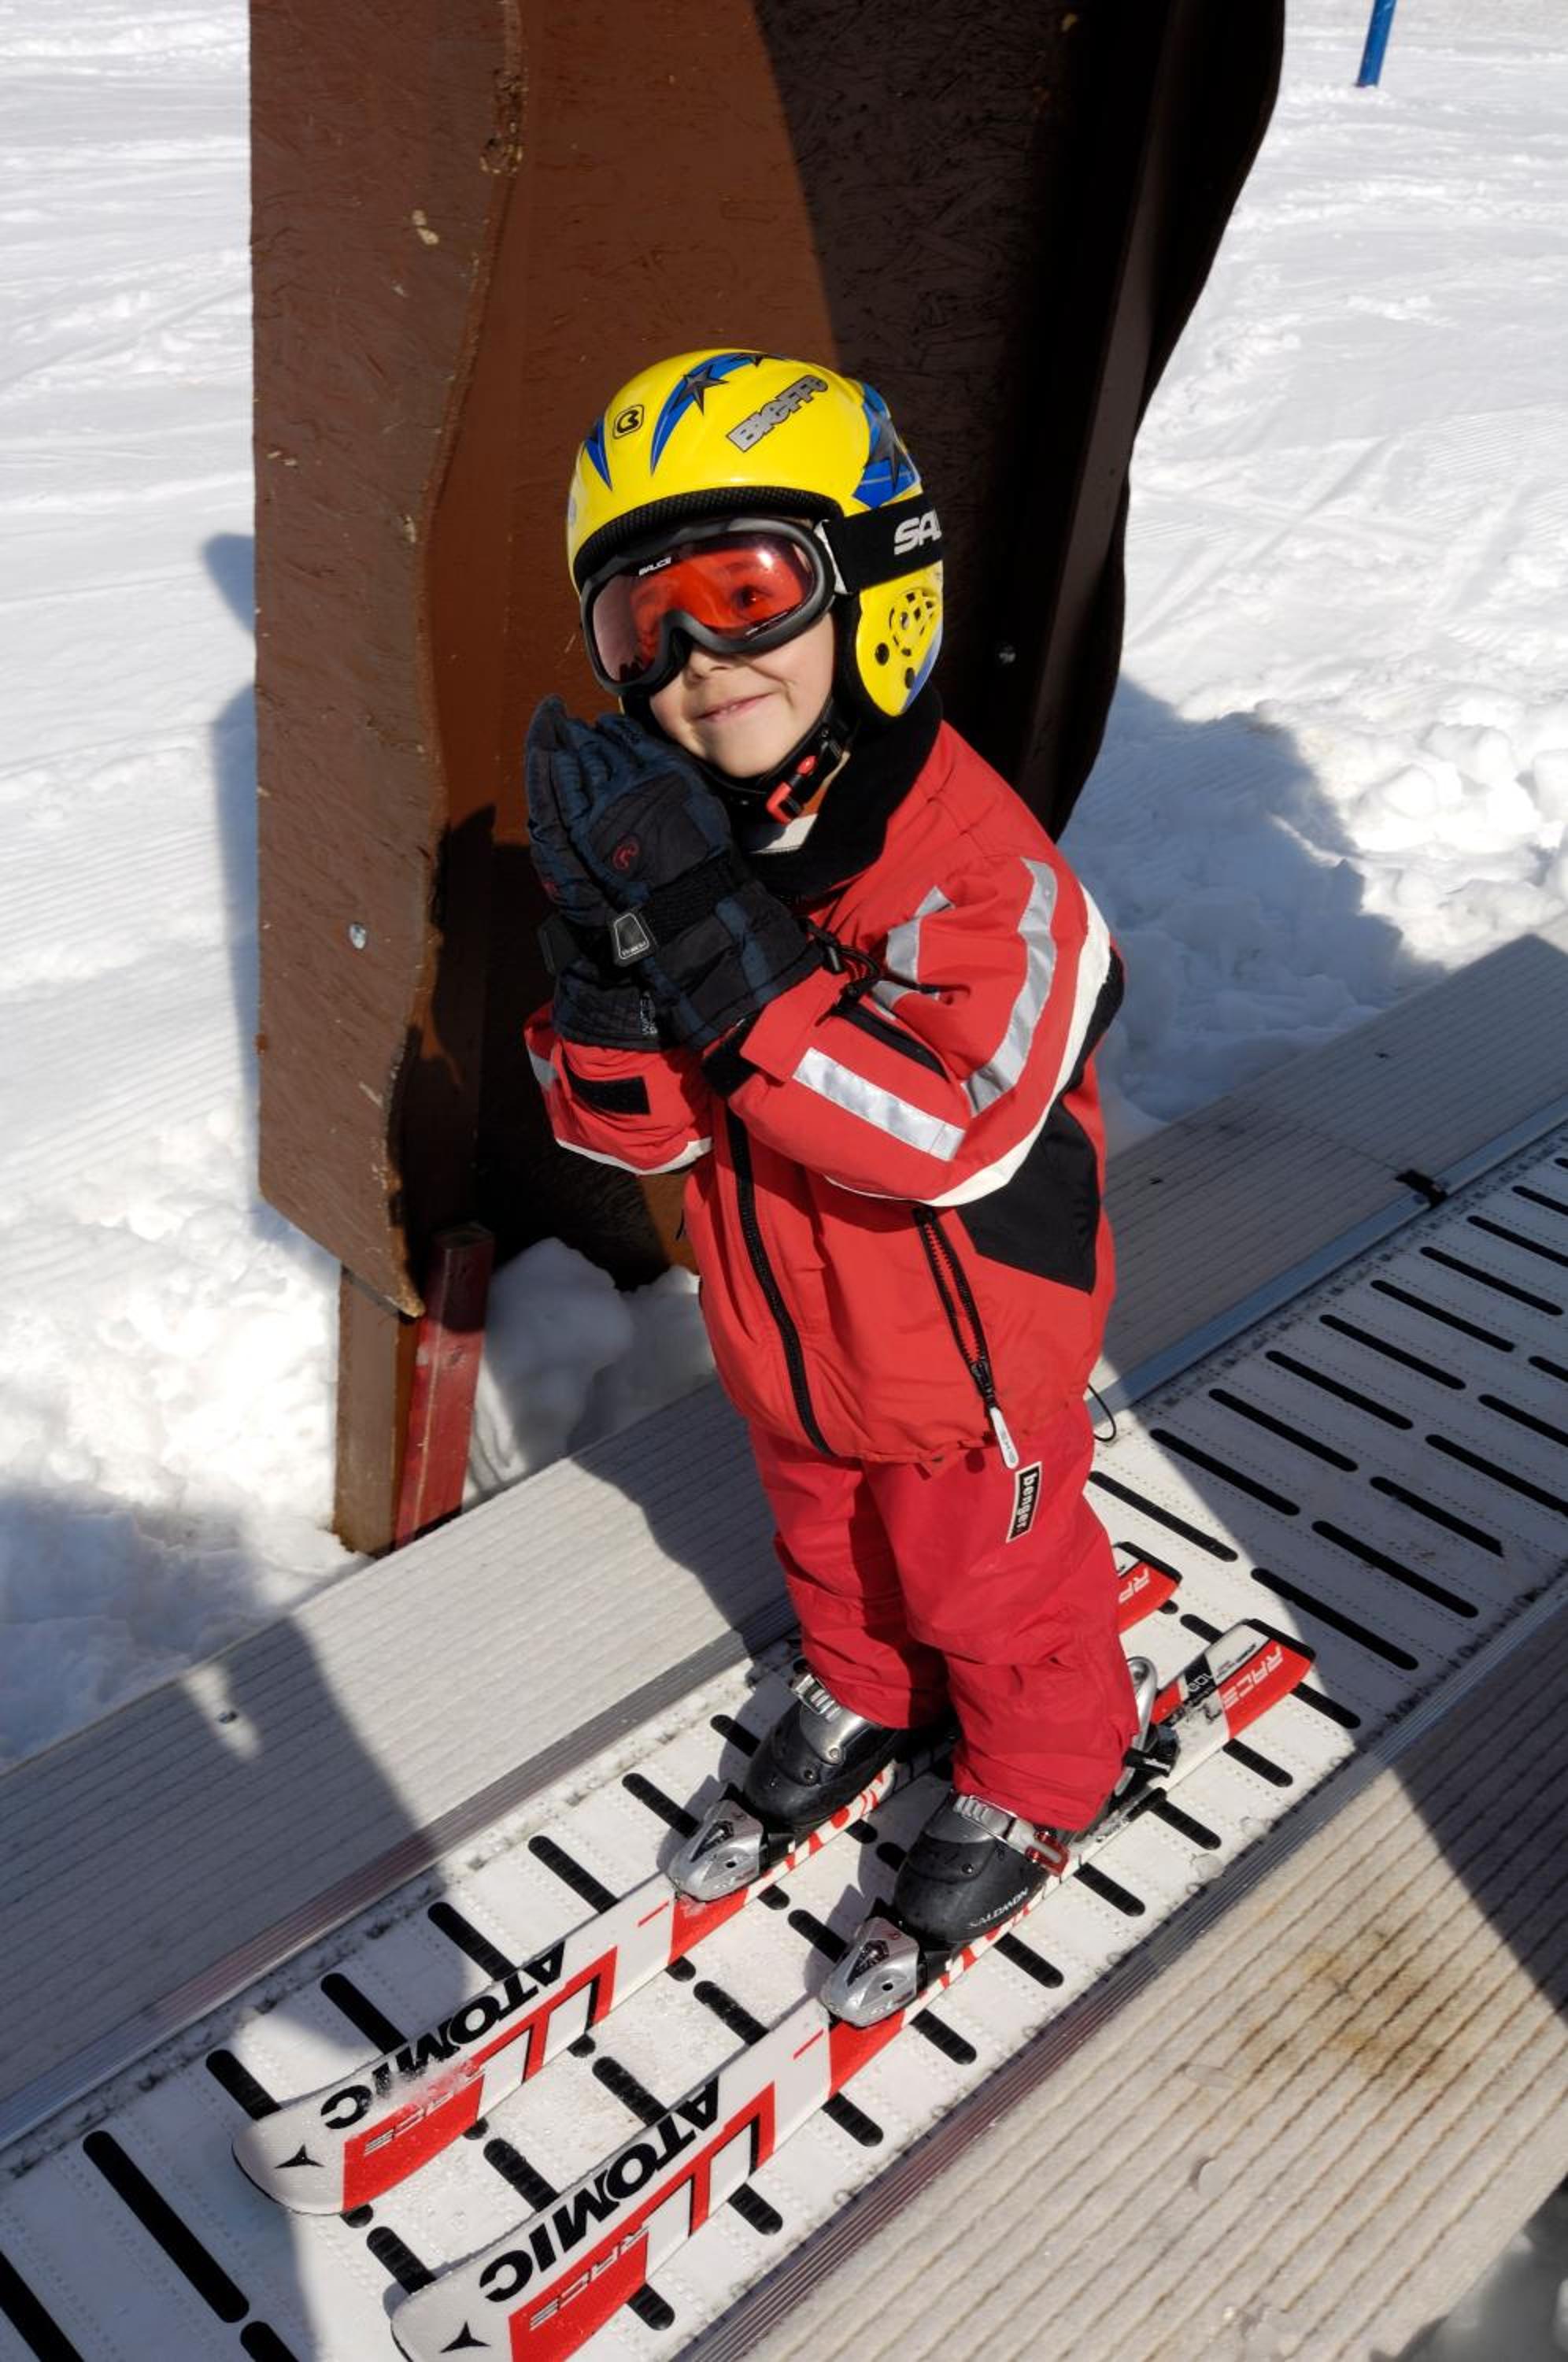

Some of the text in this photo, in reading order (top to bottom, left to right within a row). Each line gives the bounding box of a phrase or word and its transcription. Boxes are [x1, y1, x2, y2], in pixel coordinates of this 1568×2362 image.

[1015, 1472, 1038, 1529] benger
[1221, 1645, 1283, 1709] RACE
[320, 1941, 564, 2129] ATOMIC
[479, 2077, 719, 2303] ATOMIC
